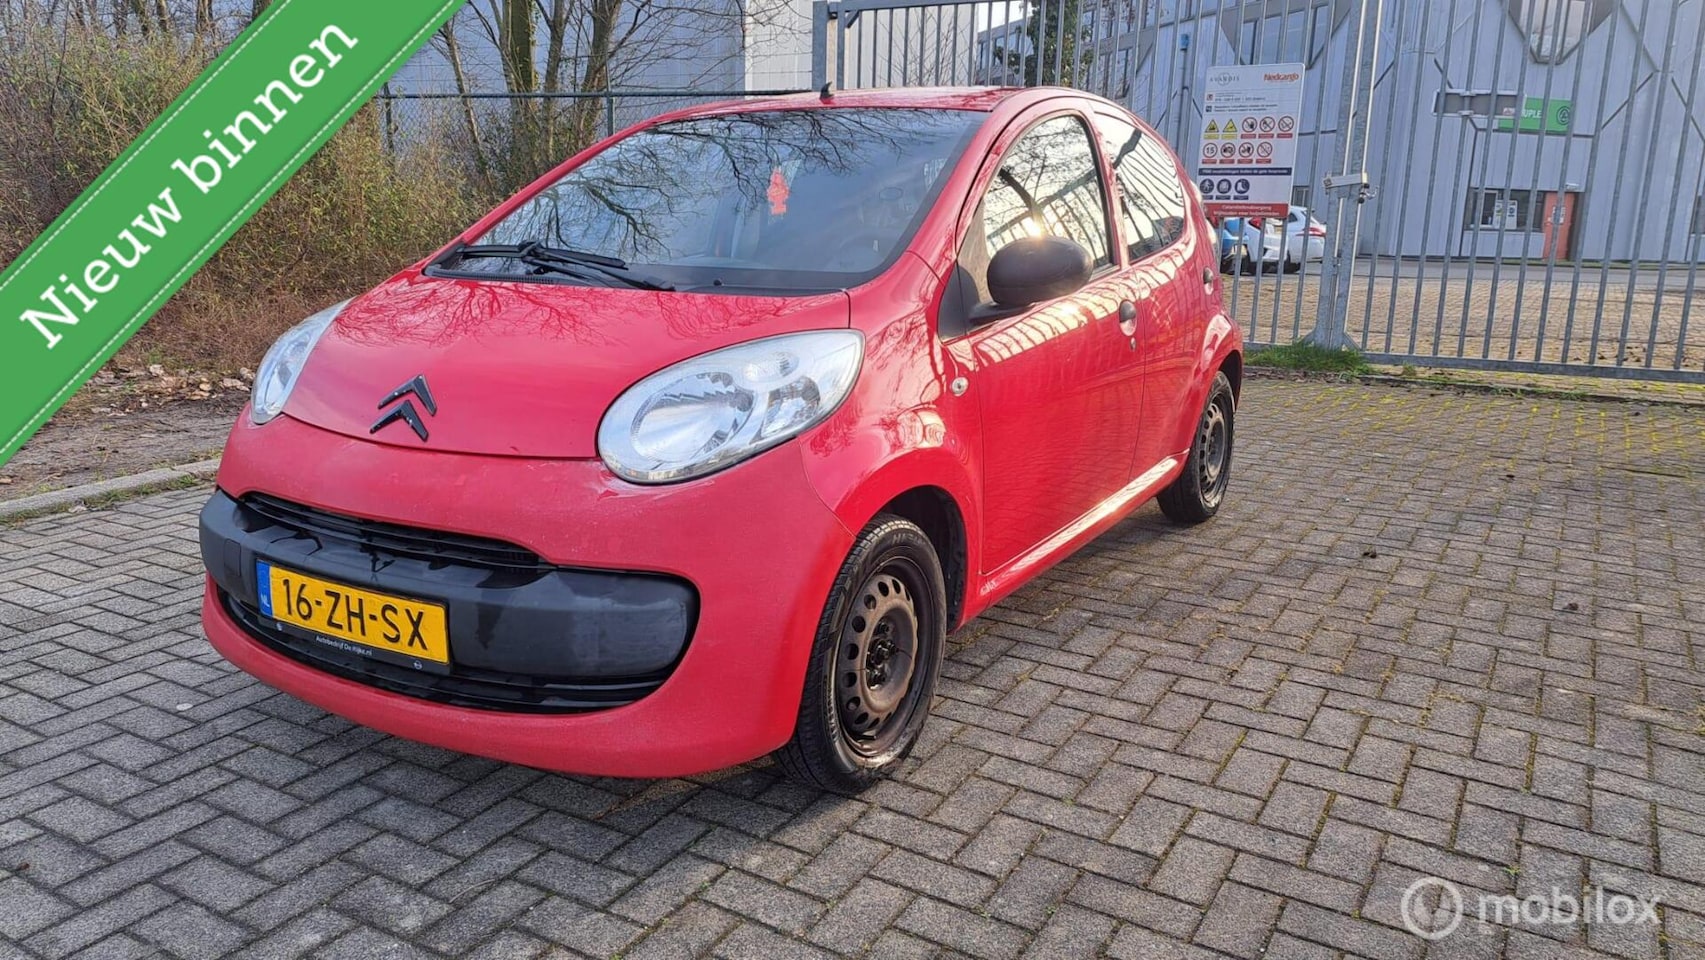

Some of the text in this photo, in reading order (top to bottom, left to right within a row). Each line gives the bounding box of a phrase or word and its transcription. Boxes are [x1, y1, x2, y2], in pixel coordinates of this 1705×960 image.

[1264, 72, 1300, 82] Nedcargo
[282, 578, 428, 650] 16-ZH-SX
[344, 643, 352, 652] De
